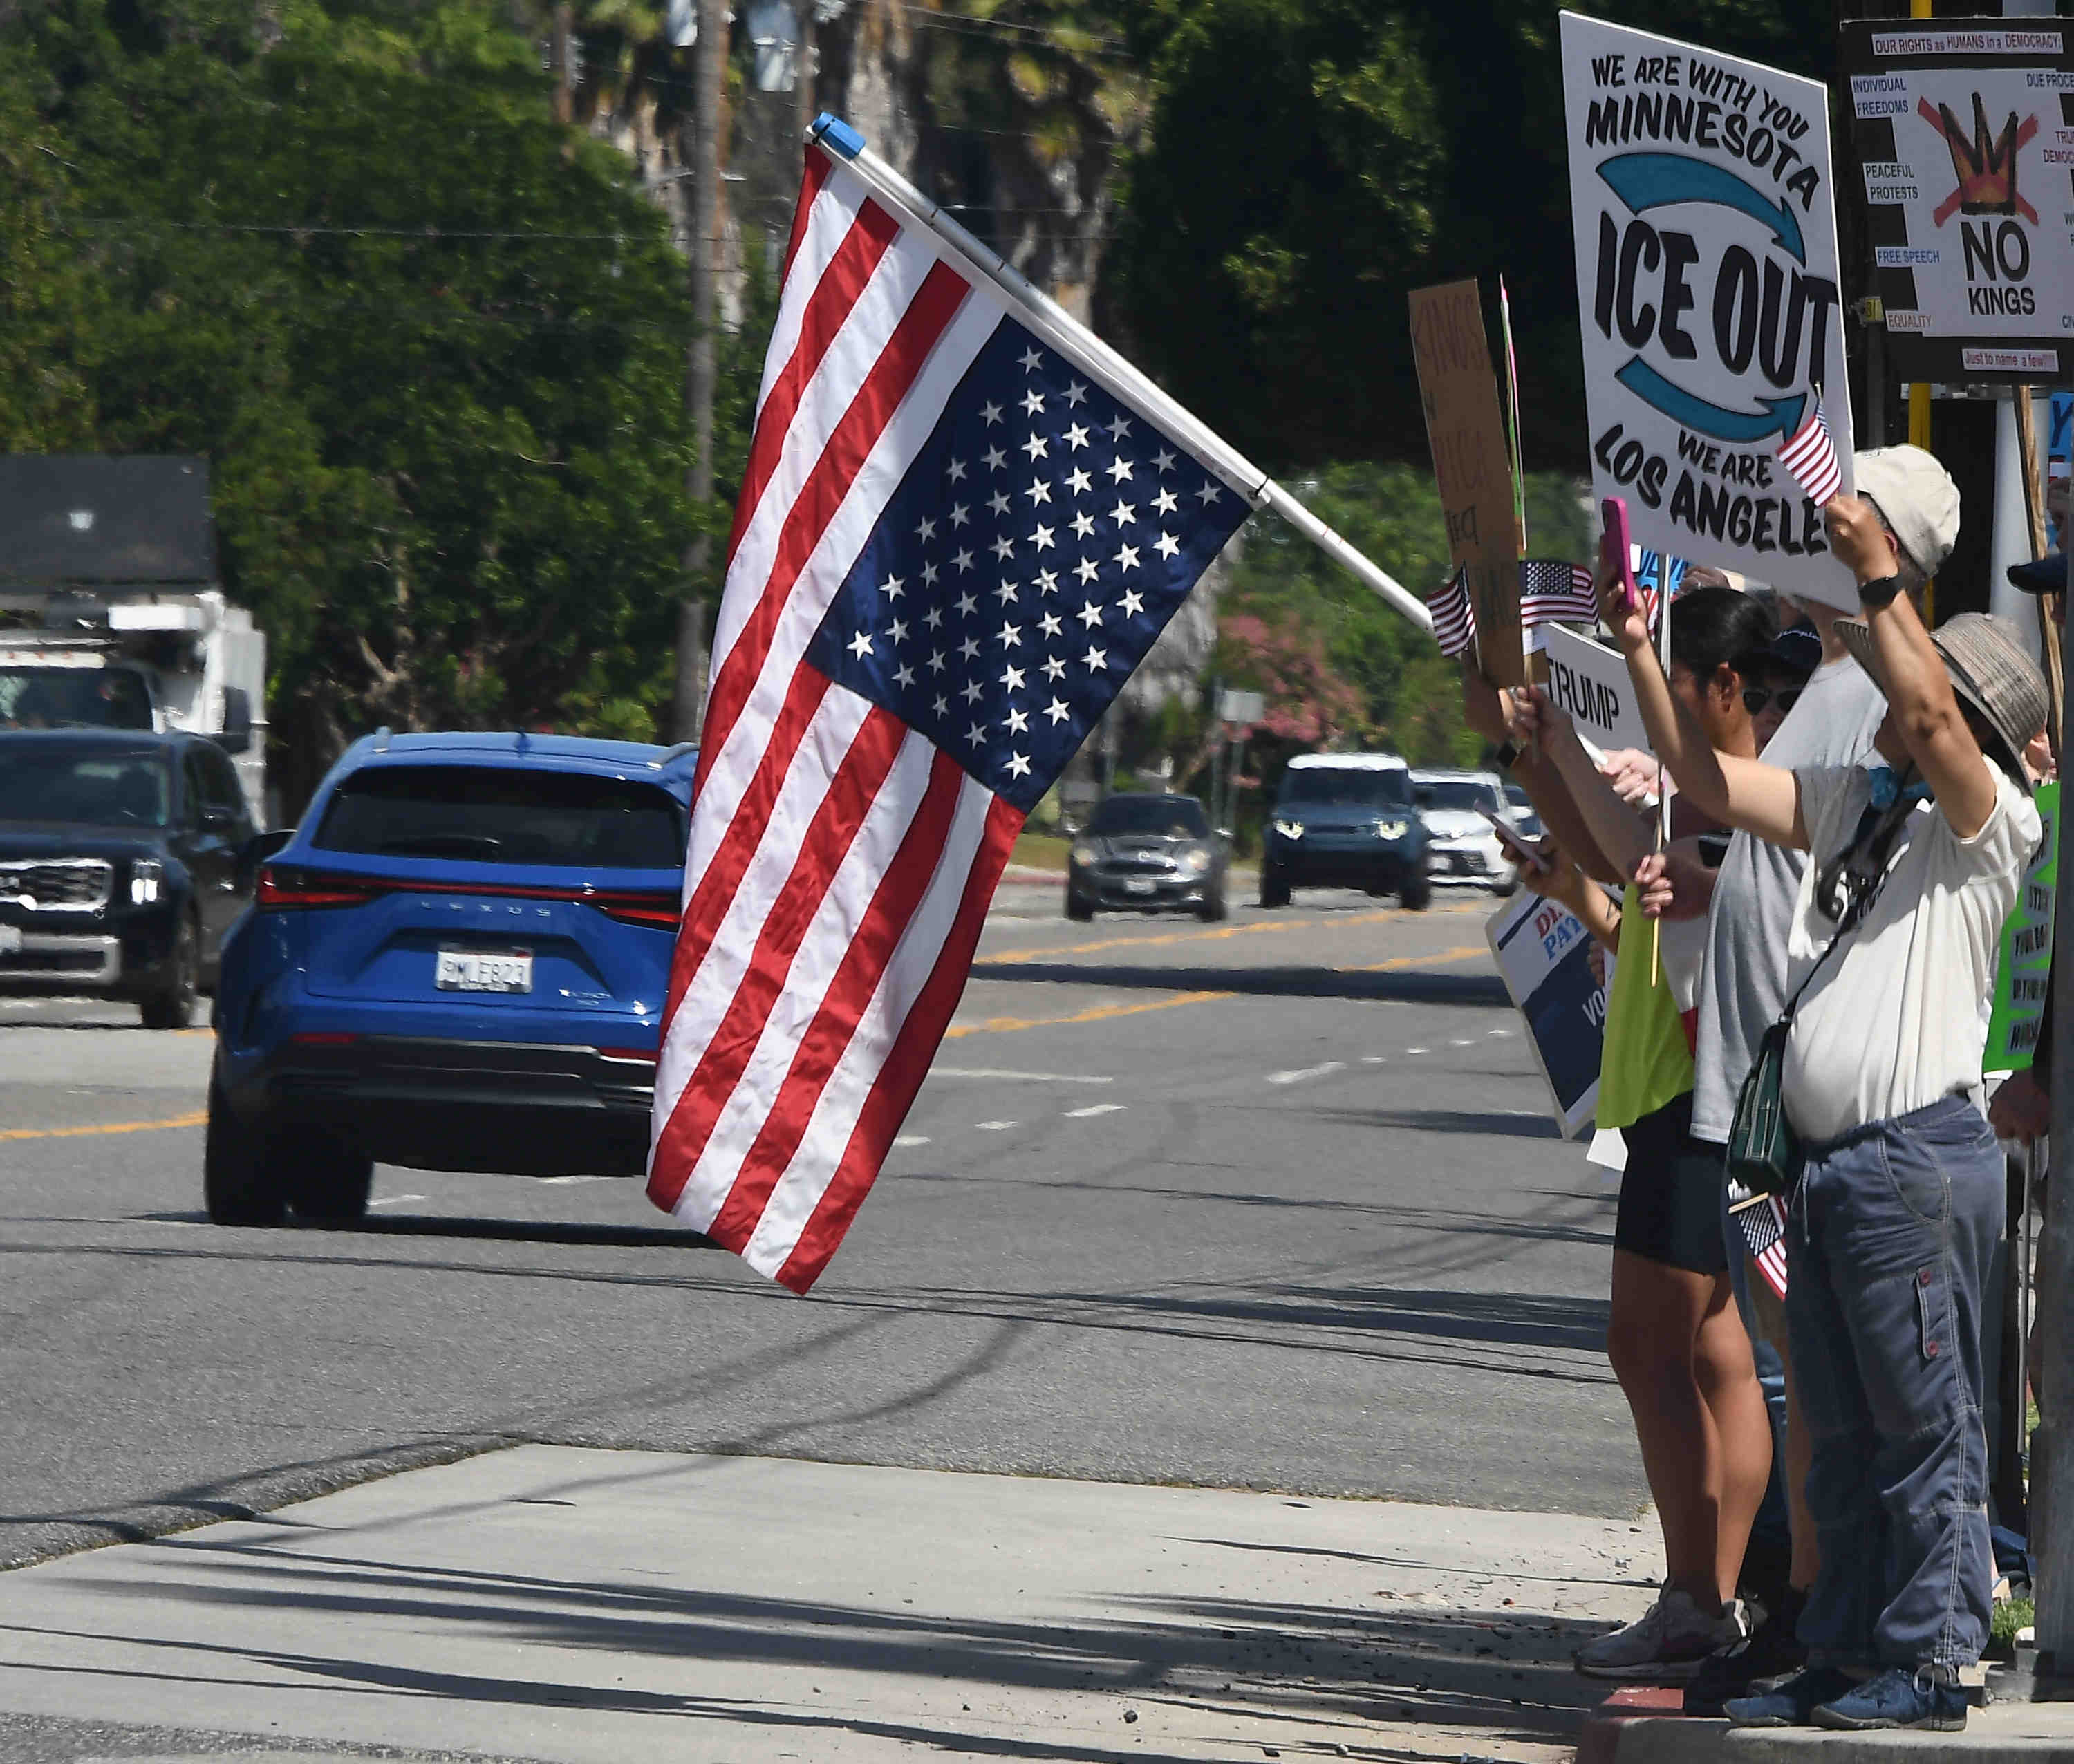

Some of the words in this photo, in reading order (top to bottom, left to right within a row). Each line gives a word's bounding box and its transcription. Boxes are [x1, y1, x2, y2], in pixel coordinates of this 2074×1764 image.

[1875, 38, 1896, 53] OUR
[1898, 37, 1933, 53] RIGHTS
[1935, 41, 1945, 52] as
[1947, 35, 1985, 49] HUMANS
[1997, 38, 2002, 48] a
[1853, 77, 1907, 93] INDIVIDUAL
[2026, 73, 2046, 88] DUE
[1592, 55, 1626, 88] WE
[1634, 55, 1681, 86] ARE
[1690, 58, 1757, 113] WITH
[1759, 88, 1809, 140] YOU
[1856, 100, 1909, 115] FREEDOMS
[1586, 91, 1820, 212] MINNESOTA
[1866, 164, 1914, 178] PEACEFUL
[1870, 186, 1918, 200] PROTESTS
[1877, 250, 1901, 263] FREE
[1903, 250, 1940, 263] SPEECH
[1961, 221, 2029, 282] NO
[1594, 210, 1699, 360] ICE
[1712, 244, 1840, 399] OUT
[1968, 287, 2035, 315] KINGS
[1887, 315, 1932, 328] EQUALITY
[1966, 350, 1984, 365] Just
[1985, 353, 1993, 365] to
[1995, 355, 2018, 366] name
[2022, 357, 2026, 367] a
[1677, 429, 1721, 475] WE
[1720, 453, 1773, 489] ARE
[1594, 424, 1668, 509] LOS
[1670, 469, 1829, 557] ANGELE
[1547, 657, 1620, 732] TRUMP
